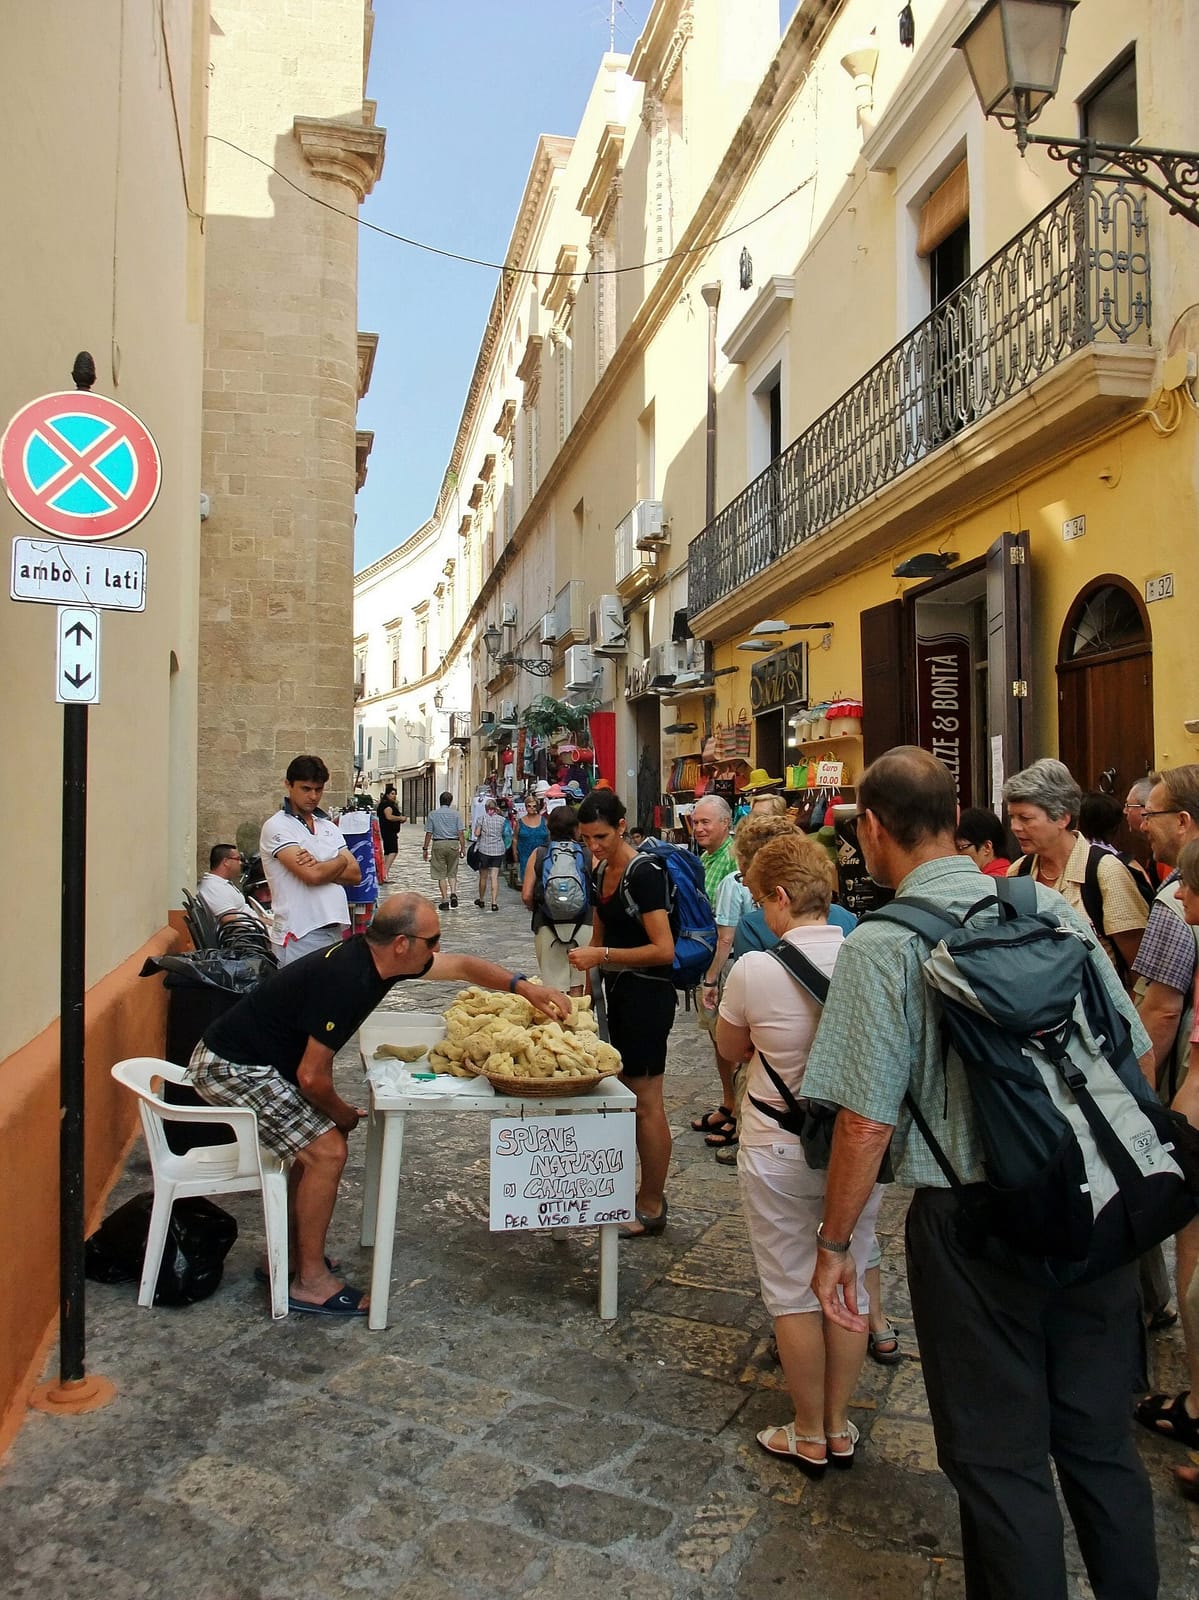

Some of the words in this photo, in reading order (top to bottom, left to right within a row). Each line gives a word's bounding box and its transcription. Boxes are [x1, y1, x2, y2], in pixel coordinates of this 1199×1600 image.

[1072, 519, 1084, 536] 34
[20, 561, 72, 583] ambo
[86, 566, 91, 585] i
[105, 568, 138, 590] lati
[1158, 576, 1172, 597] 32
[925, 654, 960, 710] BONTÀ
[932, 715, 960, 732] &
[819, 775, 839, 785] 10.00
[496, 1125, 578, 1156] SPUGNE
[1137, 1138, 1149, 1147] 32
[530, 1148, 624, 1178] NATURALI
[504, 1183, 516, 1197] DI
[539, 1200, 591, 1214] OTTIME
[505, 1214, 528, 1229] PER
[538, 1214, 571, 1227] VISO
[579, 1212, 587, 1223] E
[594, 1209, 631, 1222] CORPO
